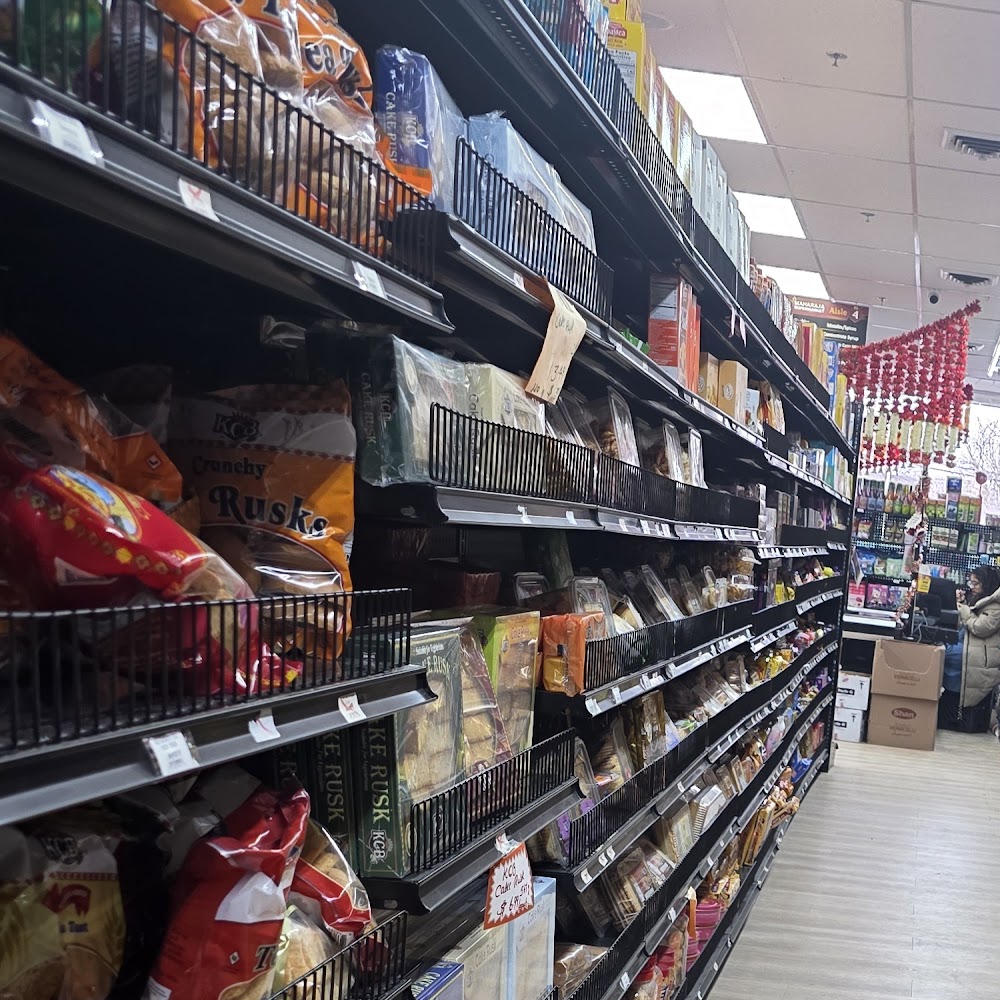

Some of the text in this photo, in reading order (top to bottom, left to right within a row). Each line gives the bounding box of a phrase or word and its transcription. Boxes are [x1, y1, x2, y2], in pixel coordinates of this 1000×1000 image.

[385, 92, 397, 134] CAKE
[852, 310, 859, 320] 4
[213, 413, 262, 441] KCB
[193, 456, 268, 480] Crunchy
[208, 485, 331, 539] Rusks
[893, 708, 915, 718] Shan
[325, 763, 345, 822] RUSK
[370, 762, 390, 823] RUSK
[370, 830, 386, 861] KCB
